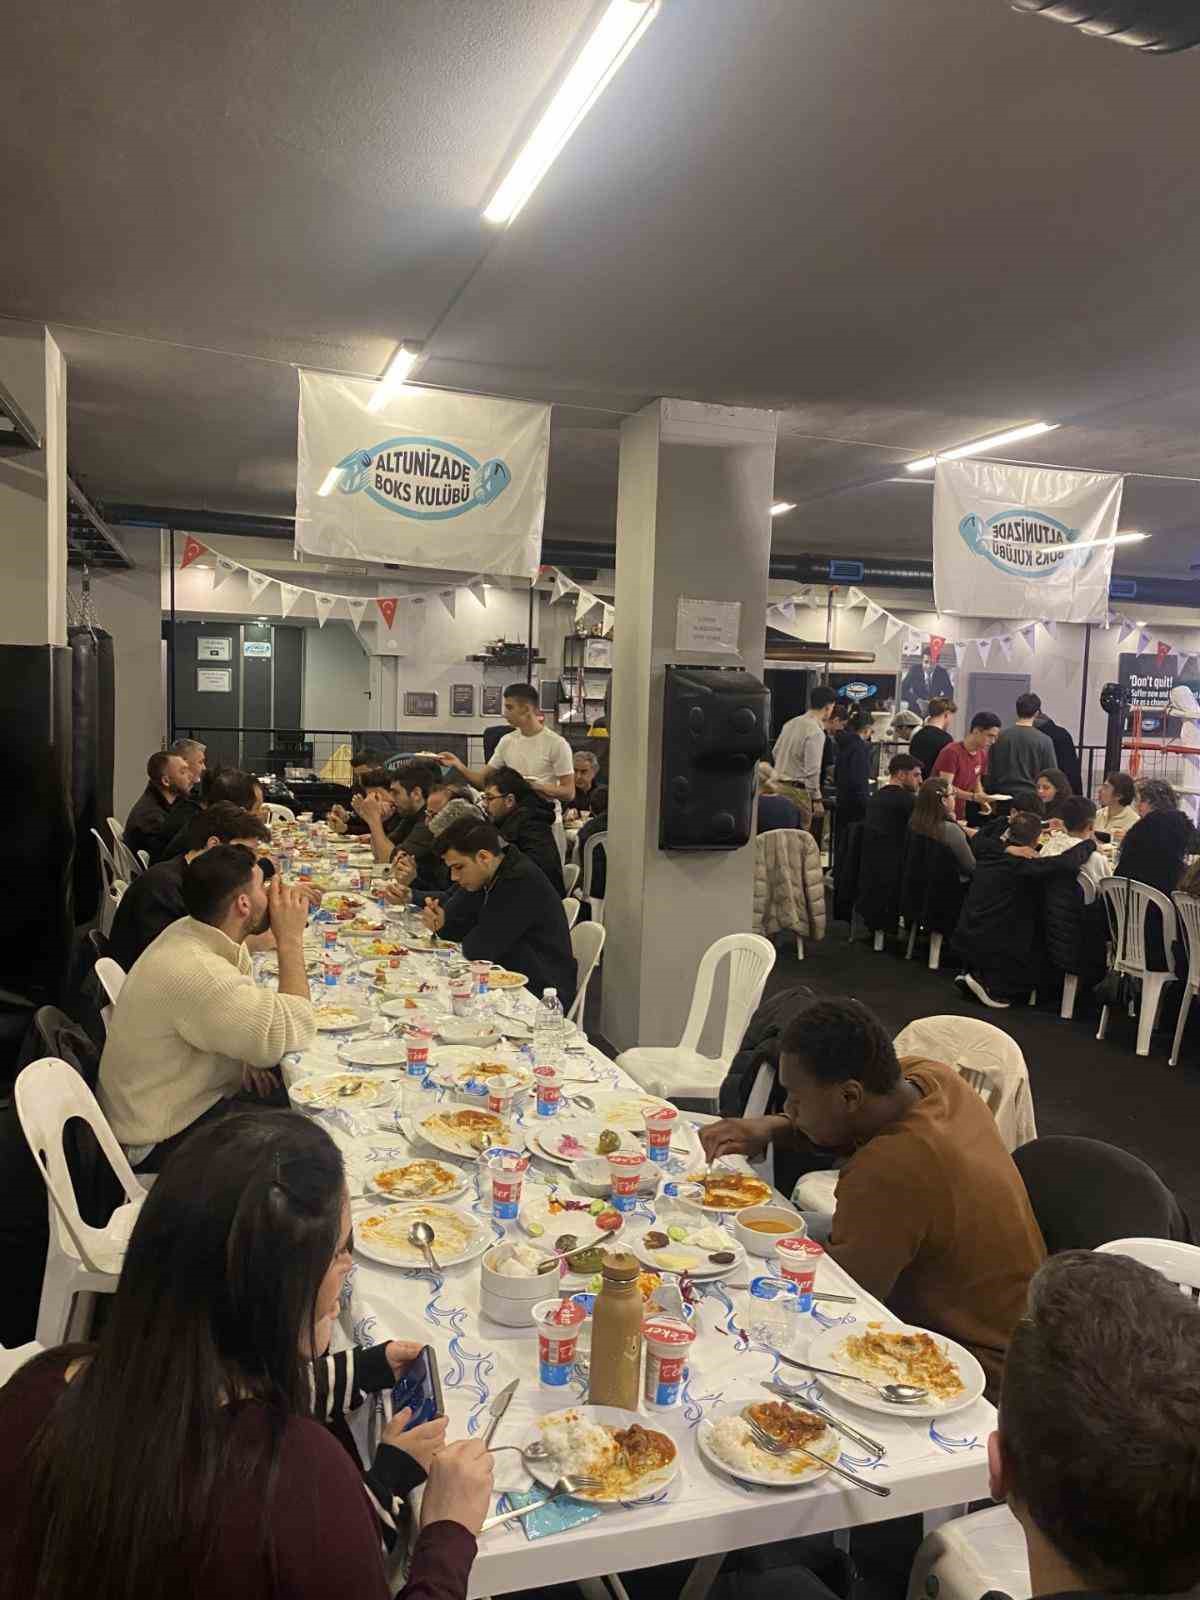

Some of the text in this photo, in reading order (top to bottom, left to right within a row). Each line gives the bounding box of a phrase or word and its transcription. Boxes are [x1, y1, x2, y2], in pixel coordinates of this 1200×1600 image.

[375, 448, 470, 482] ALTUNİZADE
[375, 473, 470, 506] BOKS KULÜBÜ
